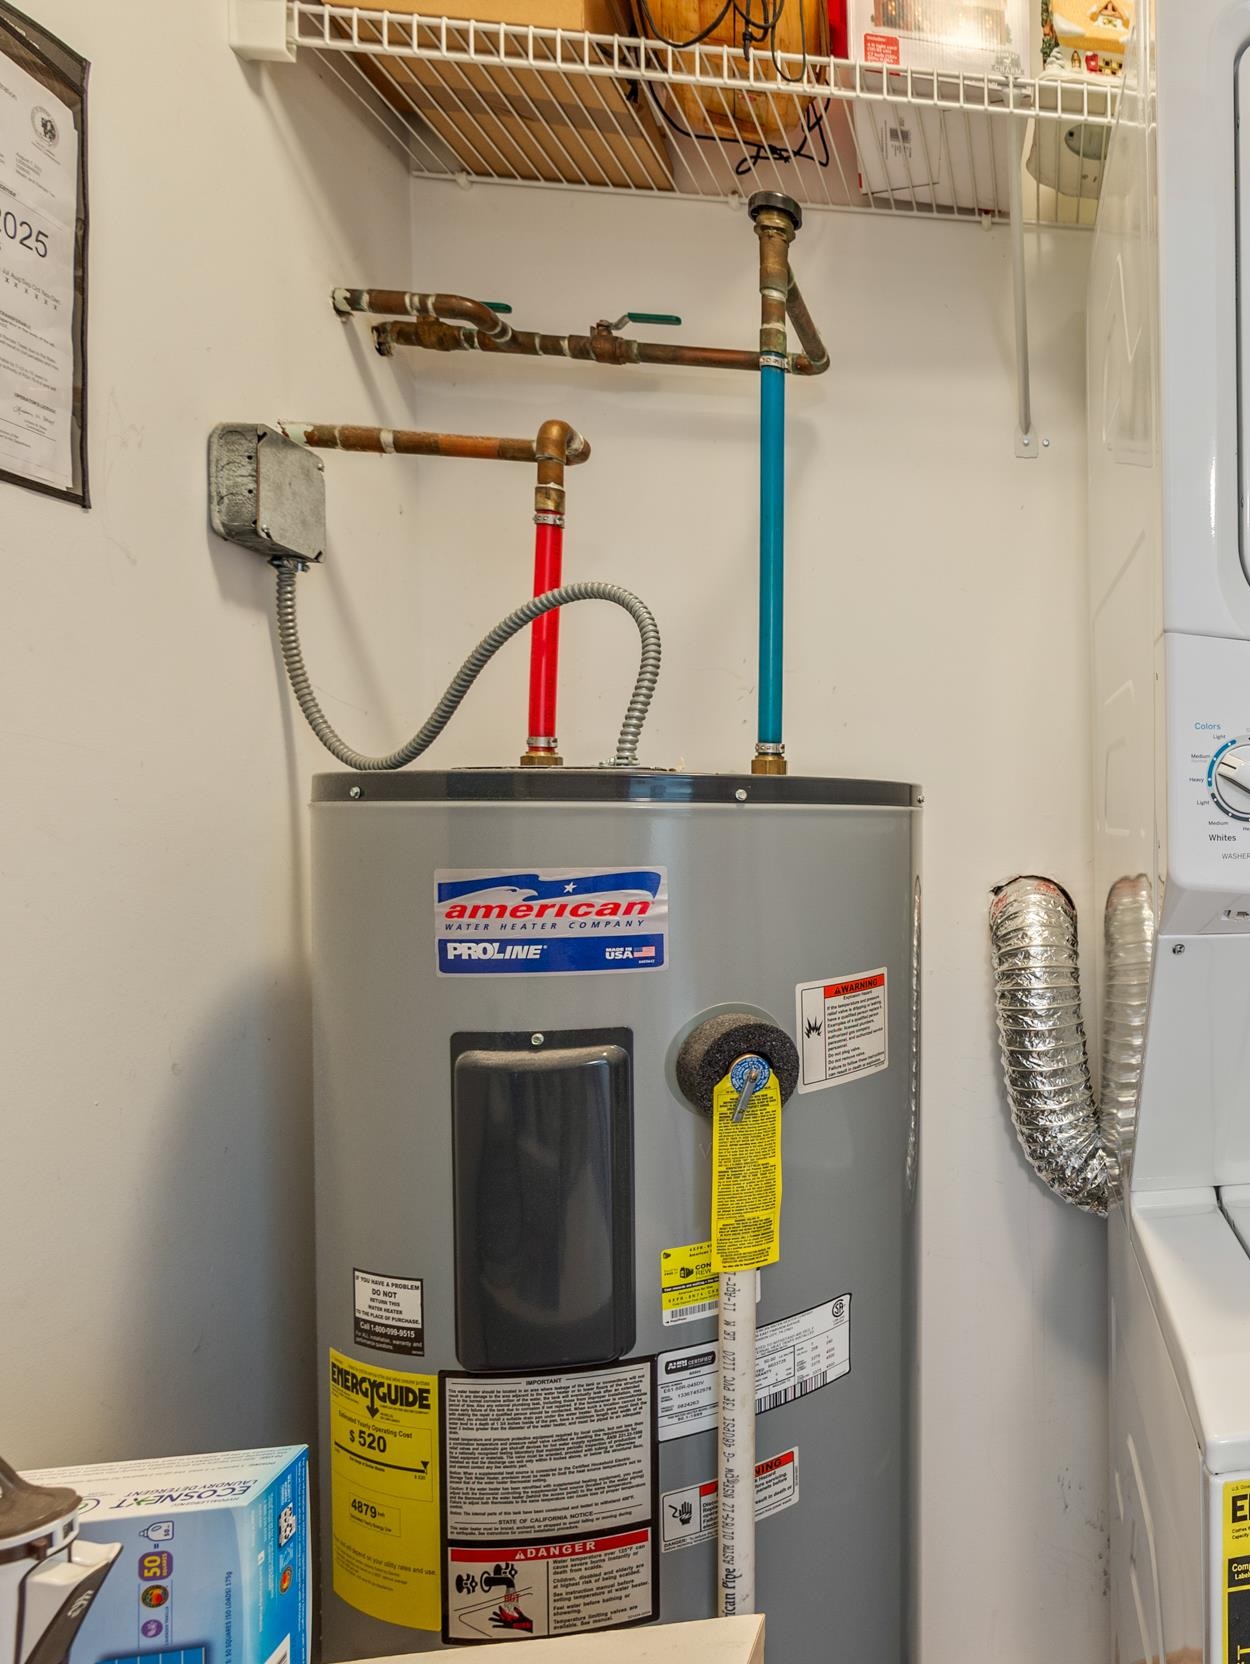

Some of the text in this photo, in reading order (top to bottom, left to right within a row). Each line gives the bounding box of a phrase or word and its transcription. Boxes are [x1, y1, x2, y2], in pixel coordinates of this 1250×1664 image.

[0, 210, 49, 258] 025
[1194, 722, 1221, 730] Colors
[1208, 834, 1237, 842] Whites
[444, 901, 652, 920] american
[444, 919, 645, 931] WATER HEATER COMPANY
[446, 942, 543, 960] PROLINE
[605, 951, 634, 960] USA
[841, 978, 878, 992] WARNING
[371, 1279, 385, 1287] HAVE
[391, 1282, 420, 1290] PROBLEM
[371, 1288, 398, 1299] DO NOT
[368, 1304, 383, 1312] WATER
[369, 1297, 388, 1306] RETURN
[360, 1321, 370, 1330] Call
[370, 1312, 384, 1320] PLACE
[391, 1317, 421, 1325] PURCHASE.
[331, 1361, 431, 1410] ENERGYGUIDE
[525, 1378, 562, 1386] IMPORTANT
[722, 1375, 736, 1392] PVC
[357, 1420, 371, 1430] Yearly
[371, 1425, 397, 1438] Operating
[398, 1430, 413, 1439] Cost
[349, 1429, 387, 1453] $ 520
[124, 1479, 258, 1497] LAUNDRY DETERGENT
[351, 1498, 377, 1519] 4879
[529, 1514, 568, 1523] CALIFORNIA
[569, 1511, 594, 1519] NOTICE
[527, 1541, 596, 1559] DANGER
[722, 1543, 735, 1565] ASTM
[143, 1555, 161, 1577] 50
[722, 1567, 742, 1590] Pipe
